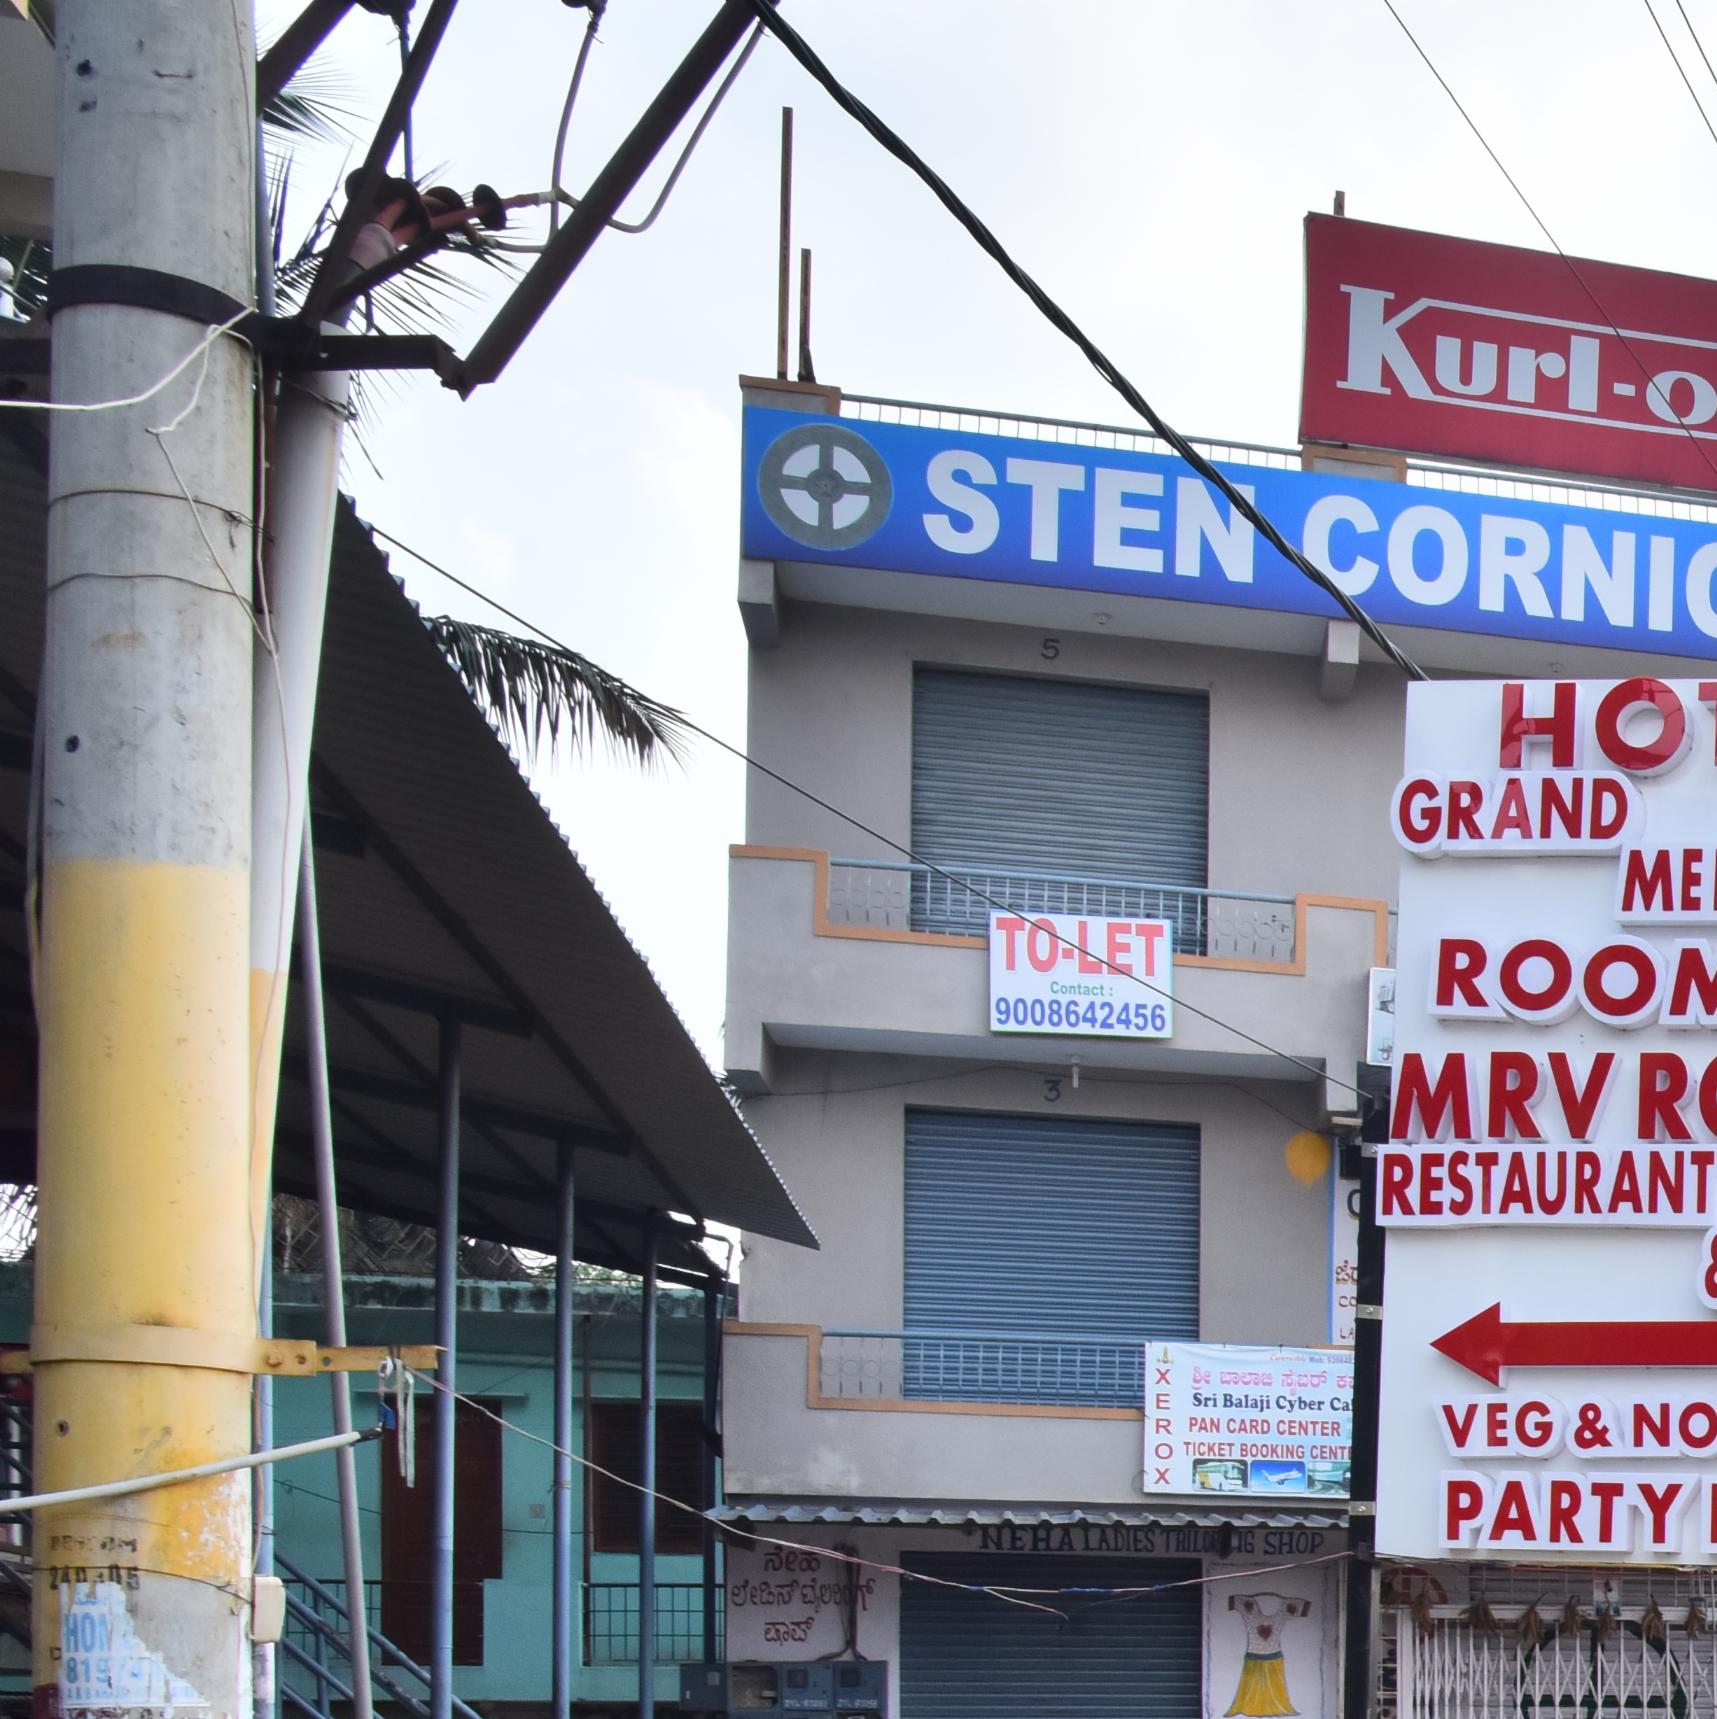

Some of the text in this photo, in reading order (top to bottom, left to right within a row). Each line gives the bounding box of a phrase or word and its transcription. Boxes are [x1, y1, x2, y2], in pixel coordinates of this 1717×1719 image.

[922, 449, 1256, 585] STEN
[1040, 638, 1061, 660] 5
[1399, 777, 1629, 844] GRAND
[995, 917, 1164, 978] TO-LET
[1050, 980, 1103, 997] Contact
[994, 998, 1167, 1032] 9008642456
[1043, 1079, 1062, 1102] 3
[1391, 1051, 1616, 1140] MRV
[1382, 1150, 1715, 1216] RESTAURANT
[1192, 1391, 1217, 1408] Sri
[1223, 1393, 1271, 1413] Balaji
[1275, 1395, 1325, 1413] Cyber
[1189, 1417, 1341, 1437] PAN CARD CENTER
[1442, 1400, 1553, 1448] VEG
[1574, 1402, 1611, 1449] &
[1184, 1441, 1235, 1458] TICKET
[1240, 1443, 1305, 1459] BOOKING
[1447, 1479, 1683, 1544] PARTY
[980, 1526, 1076, 1550] NEHA
[1083, 1527, 1155, 1554] LADIES
[1263, 1530, 1326, 1556] SHOP
